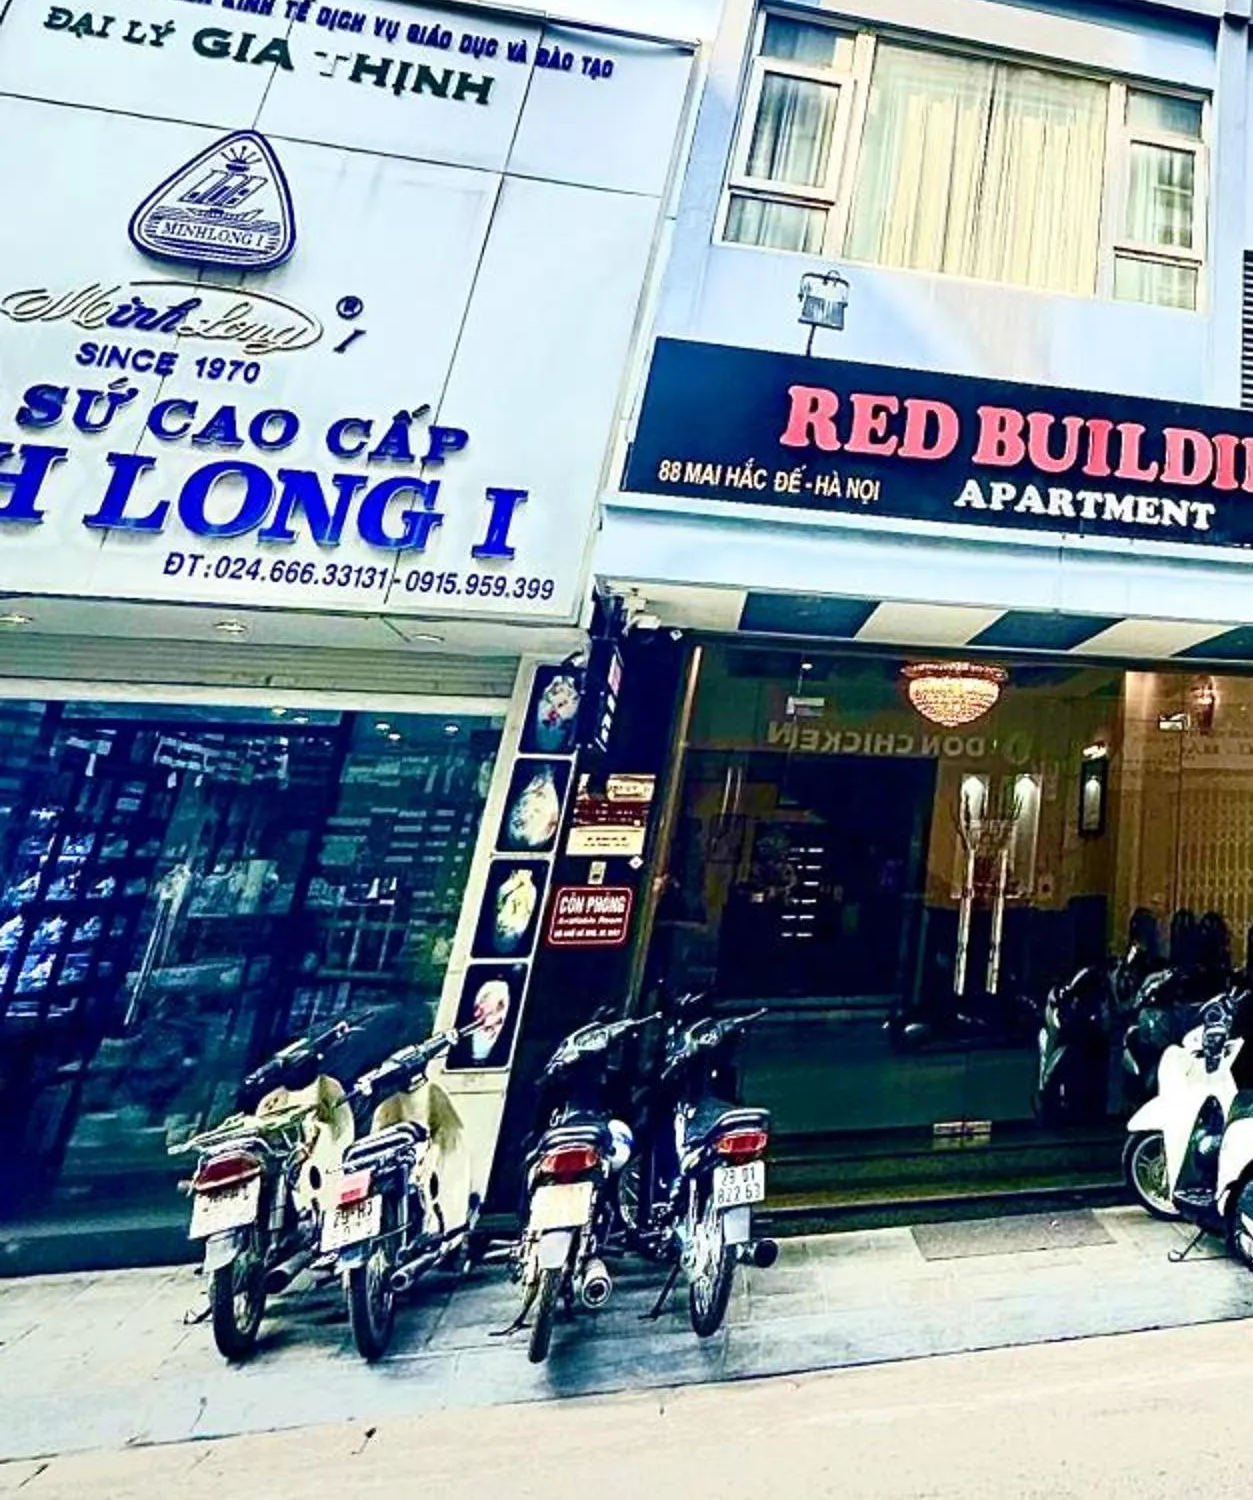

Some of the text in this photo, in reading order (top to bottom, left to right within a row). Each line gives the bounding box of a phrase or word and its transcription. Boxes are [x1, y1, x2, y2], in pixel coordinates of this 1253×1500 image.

[44, 6, 116, 39] ĐẠI
[122, 20, 176, 47] LÝ
[192, 27, 294, 71] GIA
[316, 6, 367, 35] DỊCH
[373, 17, 400, 43] VỤ
[406, 24, 452, 50] GIÁO
[459, 33, 499, 59] DỤC
[507, 39, 528, 64] VÀ
[581, 56, 615, 80] TẠO
[75, 341, 262, 384] SINCE 1970
[15, 377, 469, 466] SỨ CAO CẤP
[779, 384, 961, 461] RED
[82, 451, 446, 553] LONG
[470, 487, 531, 561] I
[658, 459, 682, 483] 88
[683, 461, 722, 486] MAI
[725, 457, 768, 490] HẮC
[953, 479, 1216, 531] APARTMENT
